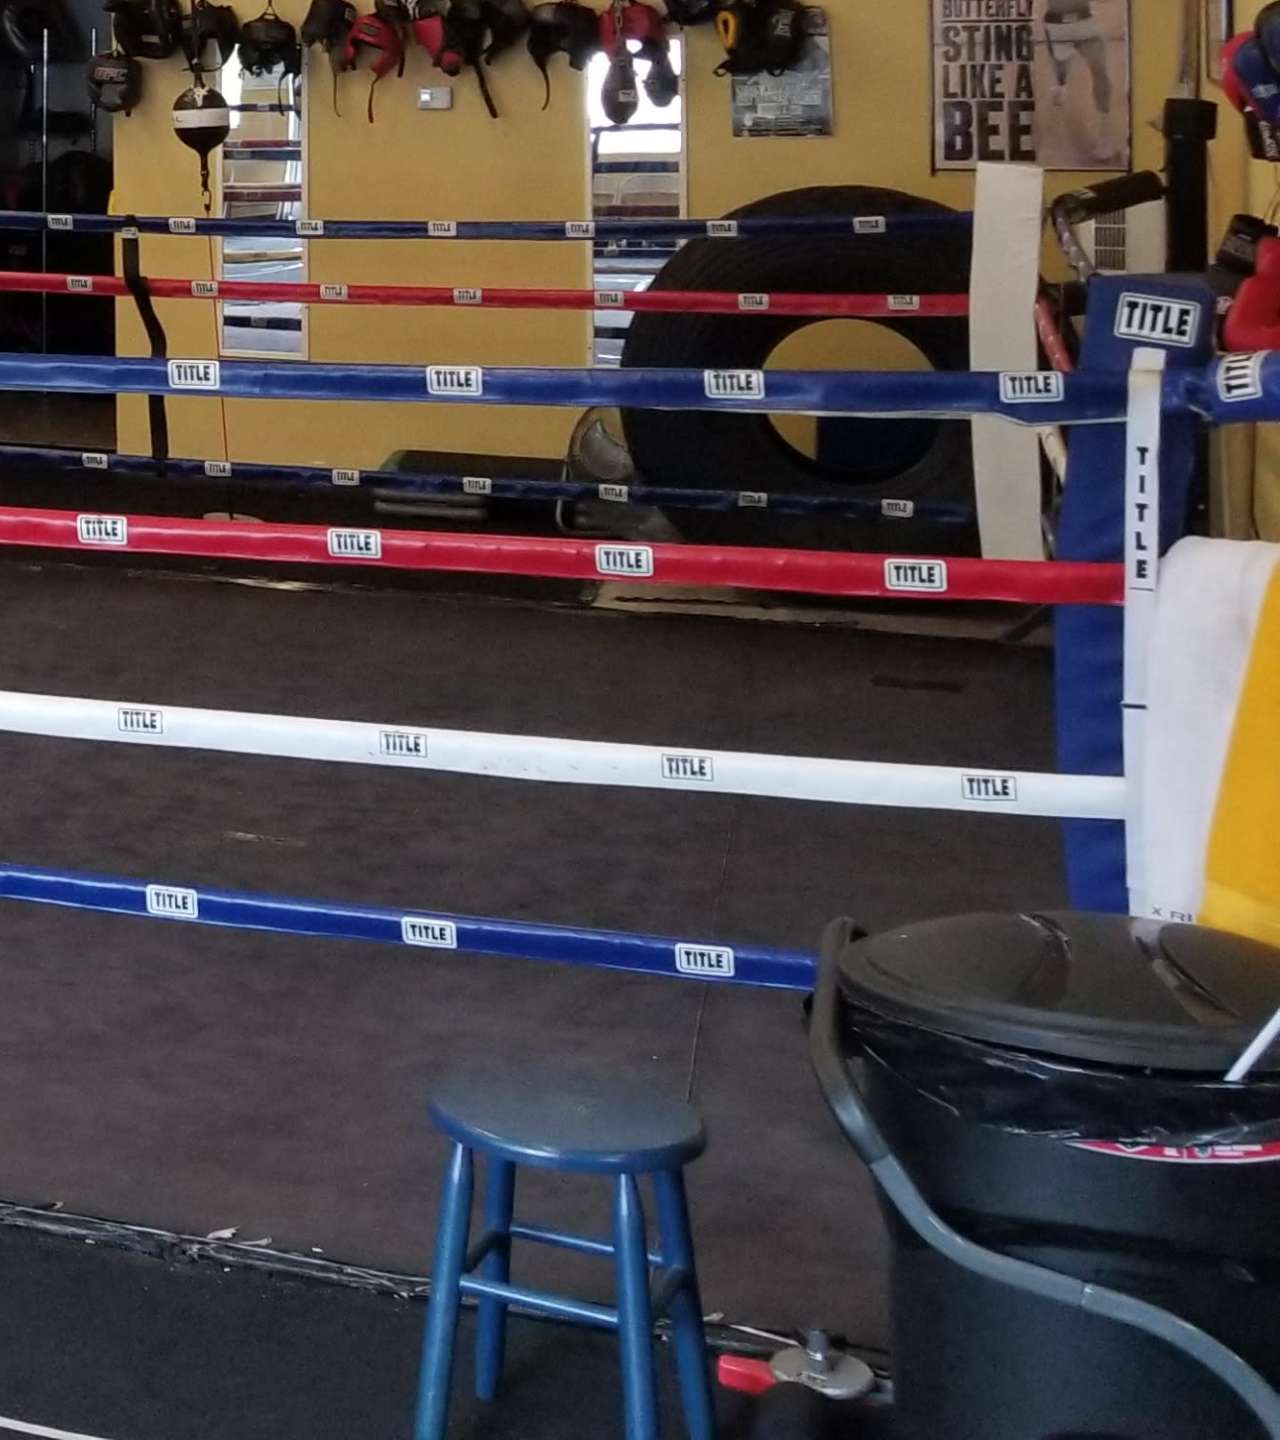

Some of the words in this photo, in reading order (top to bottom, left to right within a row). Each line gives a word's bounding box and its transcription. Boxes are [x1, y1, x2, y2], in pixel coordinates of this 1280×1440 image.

[942, 24, 1034, 62] STING
[942, 63, 1005, 99] LIKE
[1016, 64, 1034, 99] A
[943, 100, 1036, 161] BEE
[1126, 301, 1190, 337] TITLE
[175, 365, 211, 381] TITLE
[434, 371, 472, 387] TITLE
[713, 372, 753, 391] TITLE
[1224, 356, 1253, 394] TITL
[1009, 376, 1052, 393] TITLE
[1136, 446, 1149, 580] TITLE
[85, 520, 118, 537] TITLE
[335, 535, 371, 551] TITLE
[604, 551, 642, 569] TITLE
[893, 566, 936, 584] TITLE
[122, 711, 157, 729] TITLE
[384, 733, 421, 752] TITLE
[666, 757, 706, 776] TITLE
[967, 779, 1009, 797] TITLE
[154, 892, 188, 909] TITLE
[410, 924, 447, 941] TITLE
[684, 951, 724, 969] TITLE
